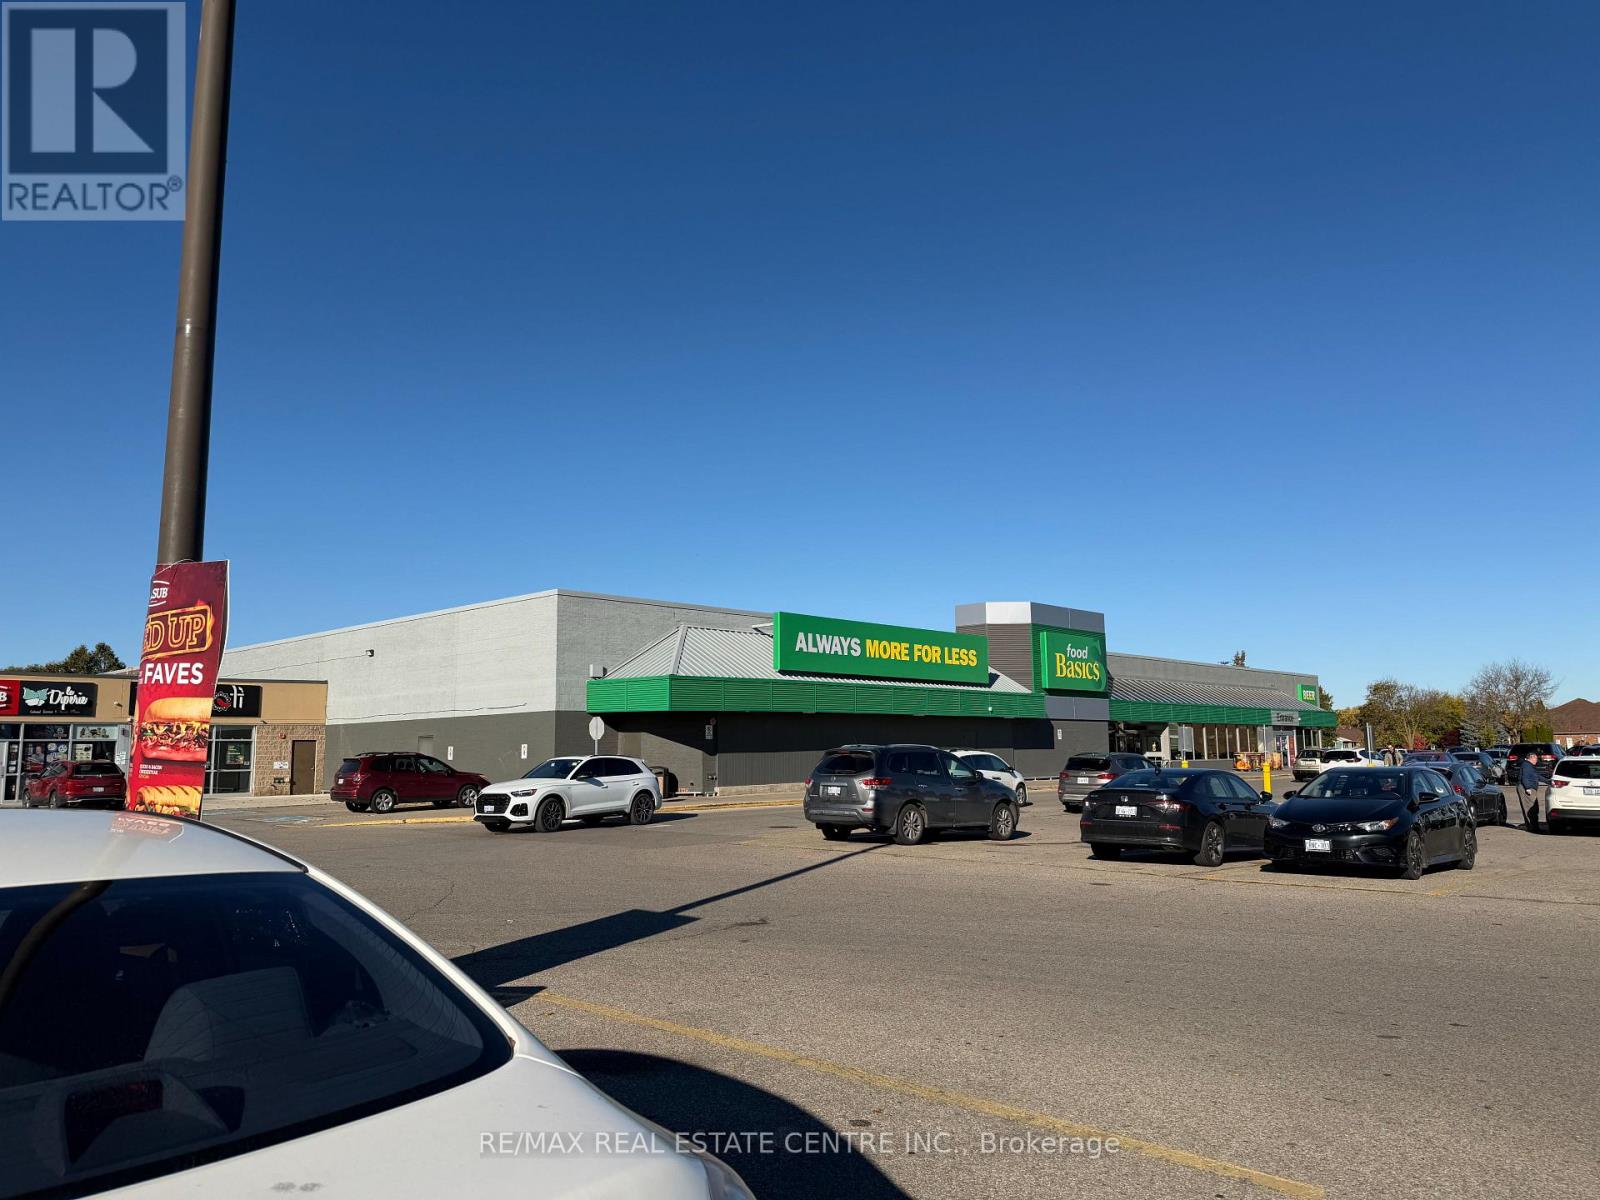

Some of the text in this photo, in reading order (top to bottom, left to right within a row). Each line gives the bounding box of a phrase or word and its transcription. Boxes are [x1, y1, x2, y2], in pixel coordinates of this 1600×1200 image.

[168, 613, 205, 648] UP
[795, 632, 977, 667] ALWAYS MORE FOR LESS
[1066, 643, 1088, 659] food
[144, 662, 204, 684] FAVES
[1055, 652, 1100, 682] Basics
